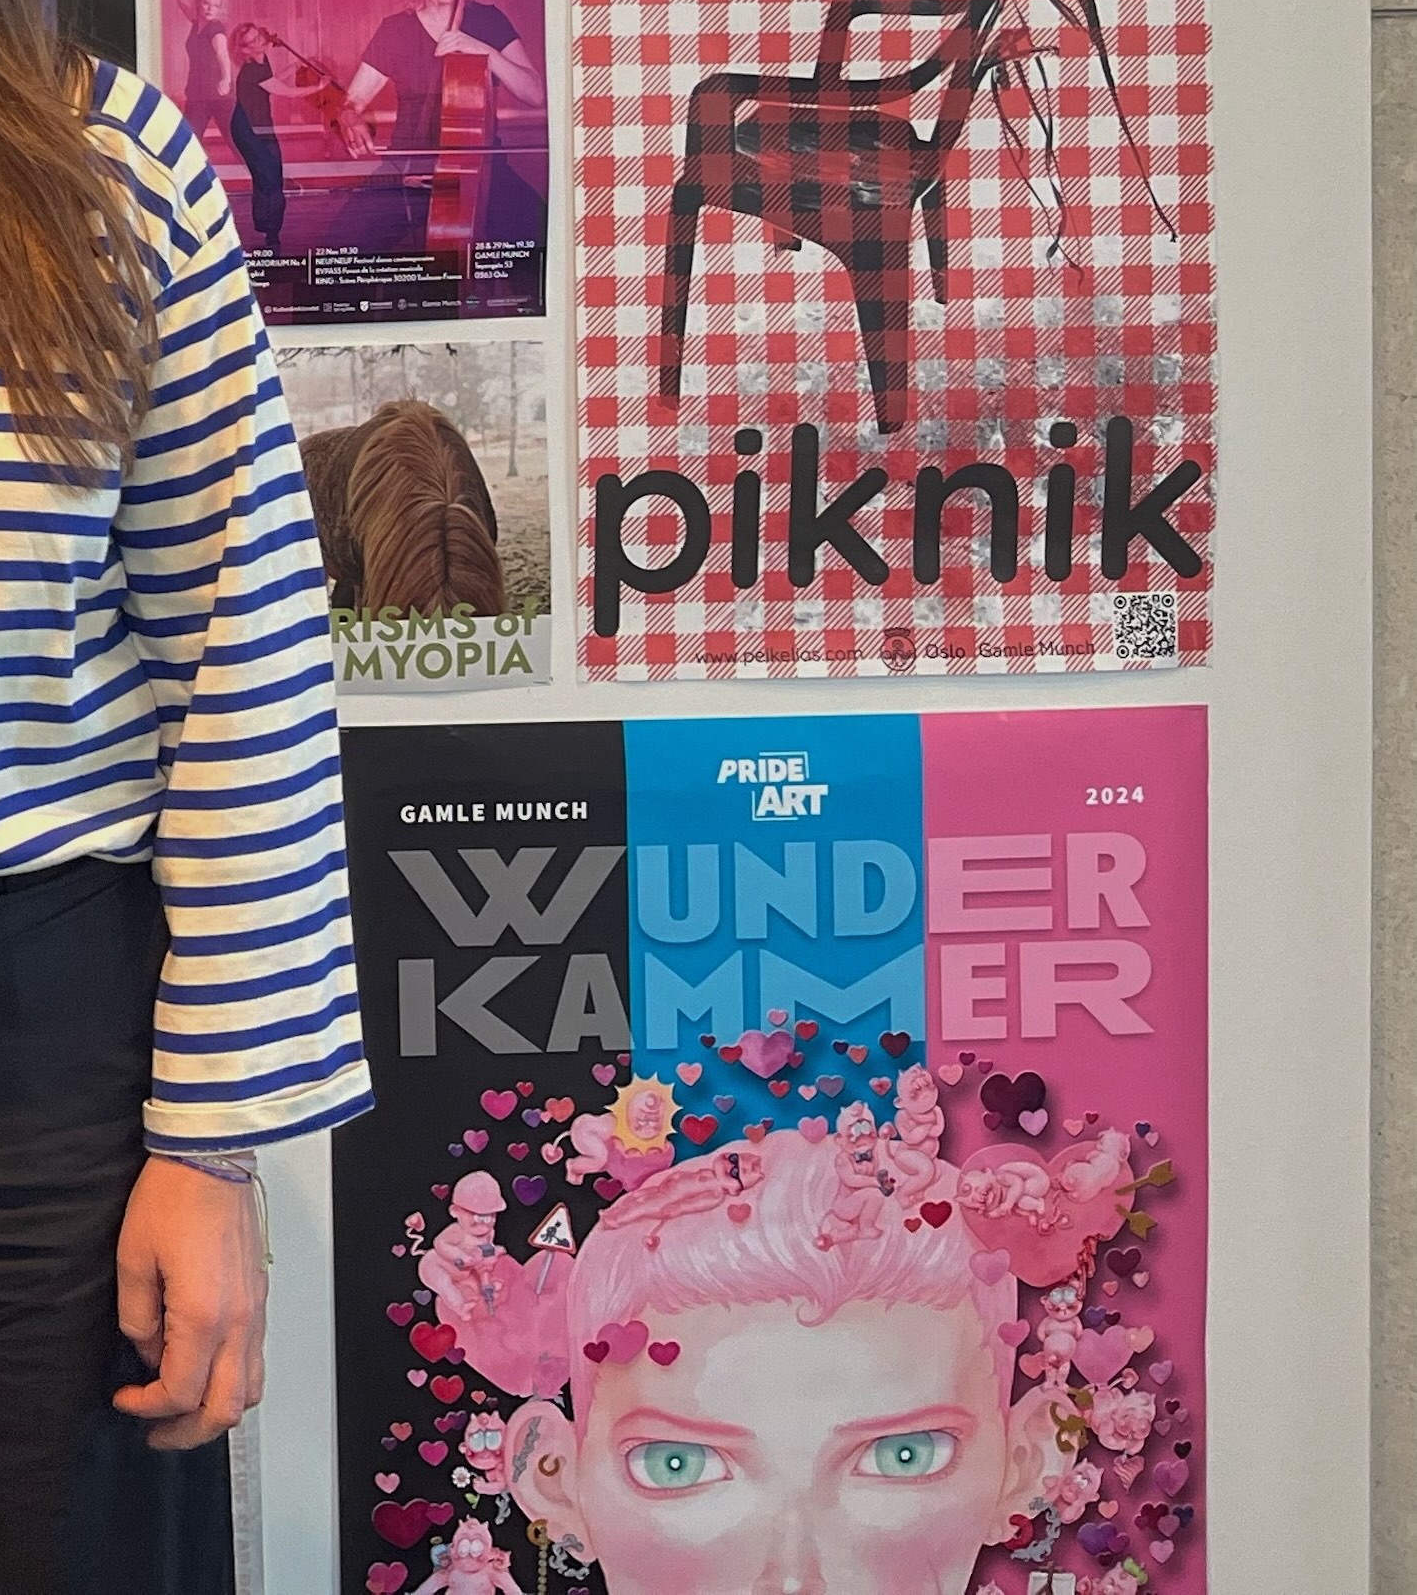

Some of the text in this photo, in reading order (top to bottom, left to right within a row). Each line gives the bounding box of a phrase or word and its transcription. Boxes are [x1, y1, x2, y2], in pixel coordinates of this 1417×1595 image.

[593, 417, 1202, 638] piknik
[329, 604, 538, 642] RISMS of
[343, 642, 533, 679] MYOPIA
[717, 757, 805, 785] PRIDE
[400, 801, 588, 824] GAMLE MUNCH
[756, 784, 828, 817] ART
[1086, 785, 1145, 806] 2024
[387, 831, 1151, 948] WUNDER
